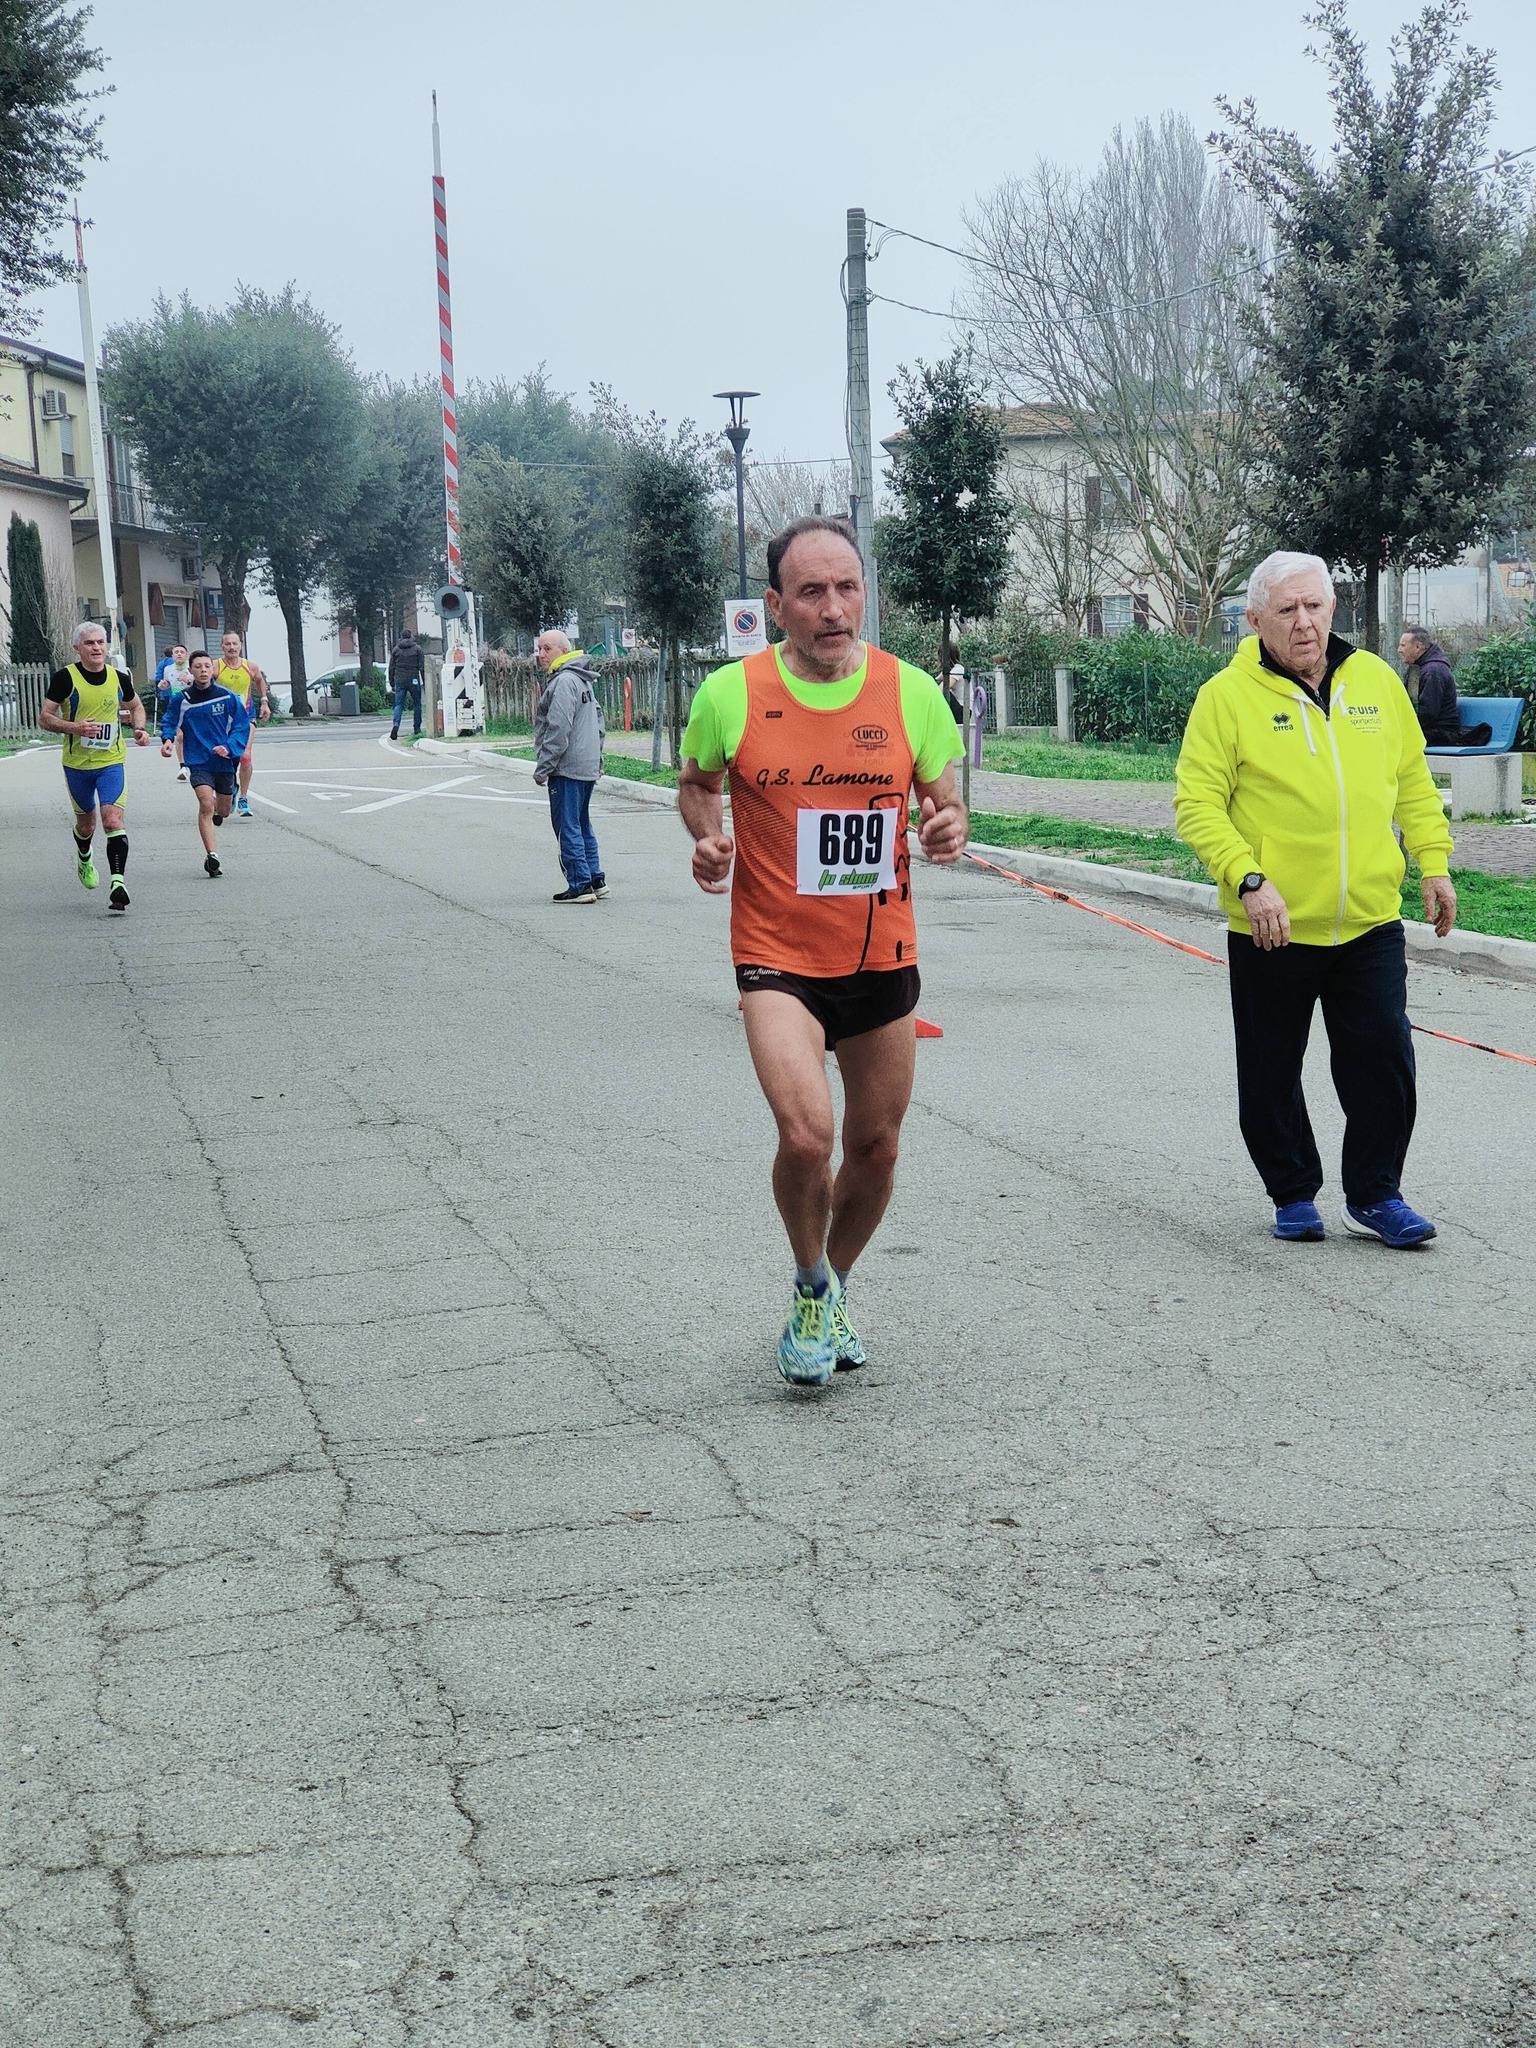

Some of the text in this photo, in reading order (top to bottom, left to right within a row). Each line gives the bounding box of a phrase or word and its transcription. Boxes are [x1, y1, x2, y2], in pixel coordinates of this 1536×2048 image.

[1358, 706, 1379, 715] UISP
[857, 729, 884, 740] LUCCI
[756, 764, 894, 790] G.S. Lamone
[819, 813, 884, 866] 689
